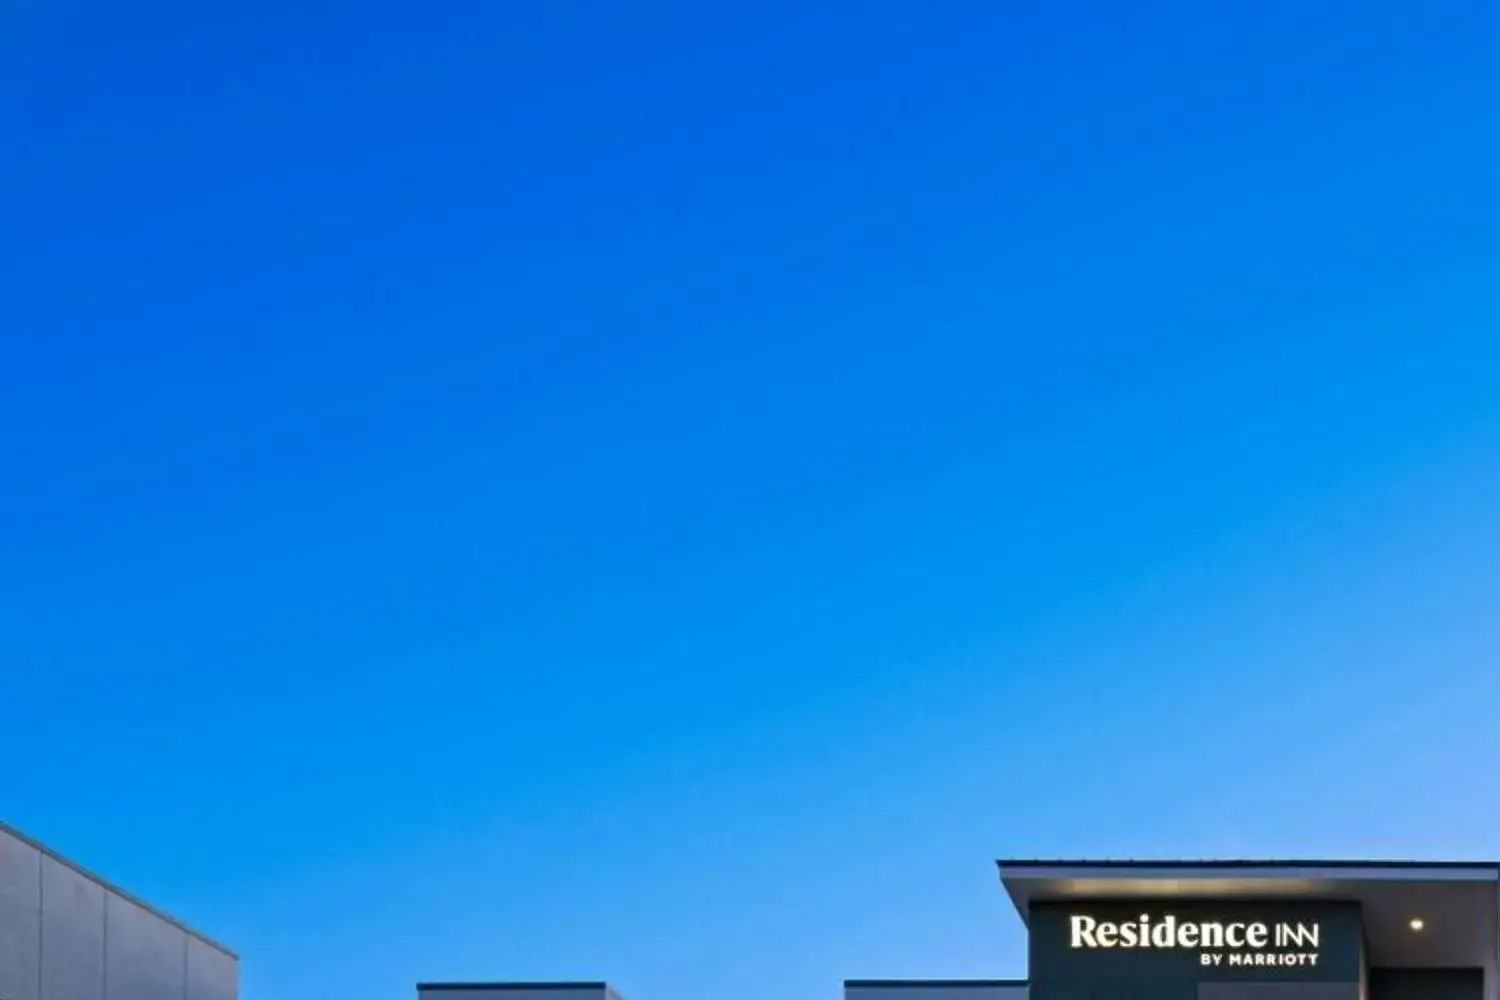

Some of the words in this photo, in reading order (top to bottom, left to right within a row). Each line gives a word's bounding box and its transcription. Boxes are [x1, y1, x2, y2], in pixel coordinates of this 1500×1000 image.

[1070, 914, 1268, 948] Residence
[1275, 923, 1319, 947] INN
[1200, 953, 1222, 966] BY
[1229, 953, 1319, 966] MARRIOTT
